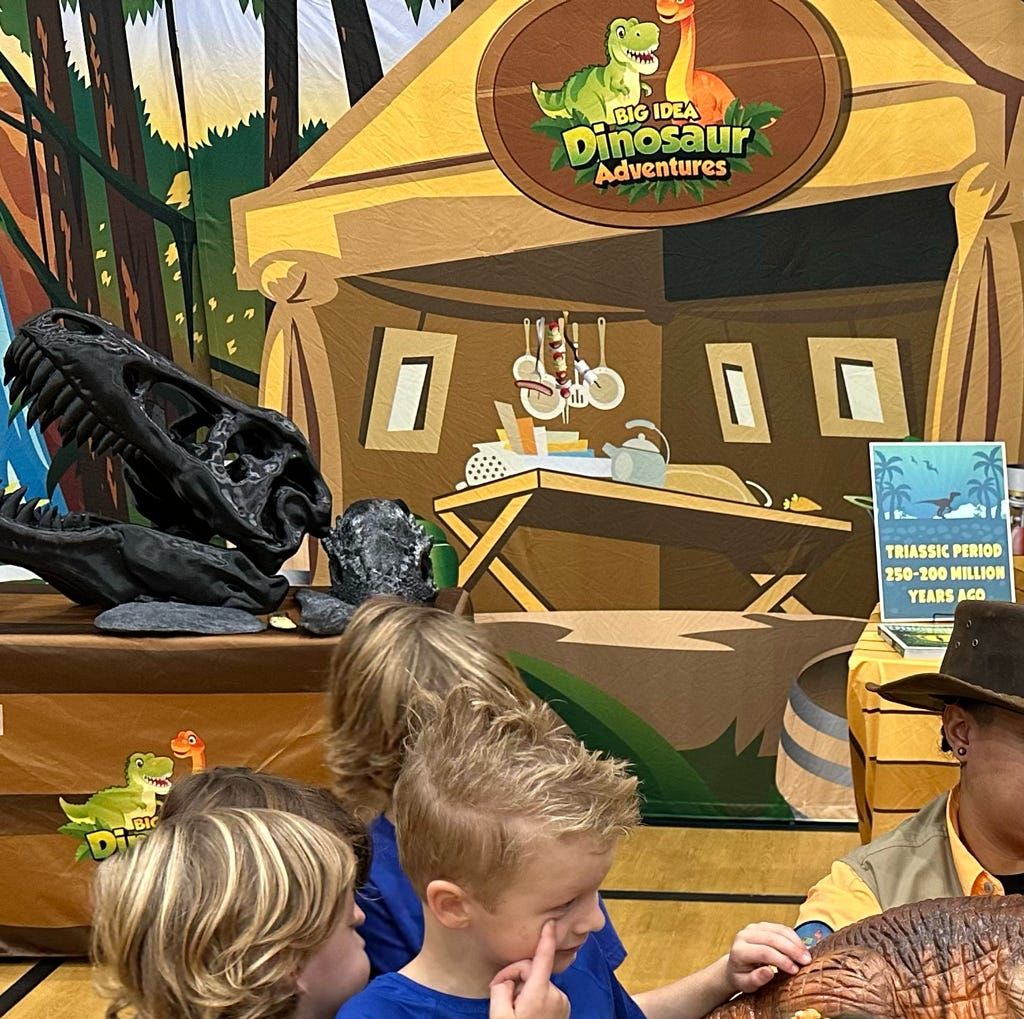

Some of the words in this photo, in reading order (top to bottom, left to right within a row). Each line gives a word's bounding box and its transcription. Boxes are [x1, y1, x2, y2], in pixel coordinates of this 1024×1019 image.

[614, 105, 649, 125] BIG
[653, 102, 699, 121] IDEA
[562, 122, 751, 167] Dinosaur
[594, 156, 728, 185] Adventures
[885, 544, 950, 559] TRIASSIC
[952, 543, 1003, 559] PERIOD
[885, 566, 948, 581] 250-200
[950, 566, 1005, 580] MILLION
[908, 588, 955, 603] YEARS
[957, 588, 986, 602] AGO
